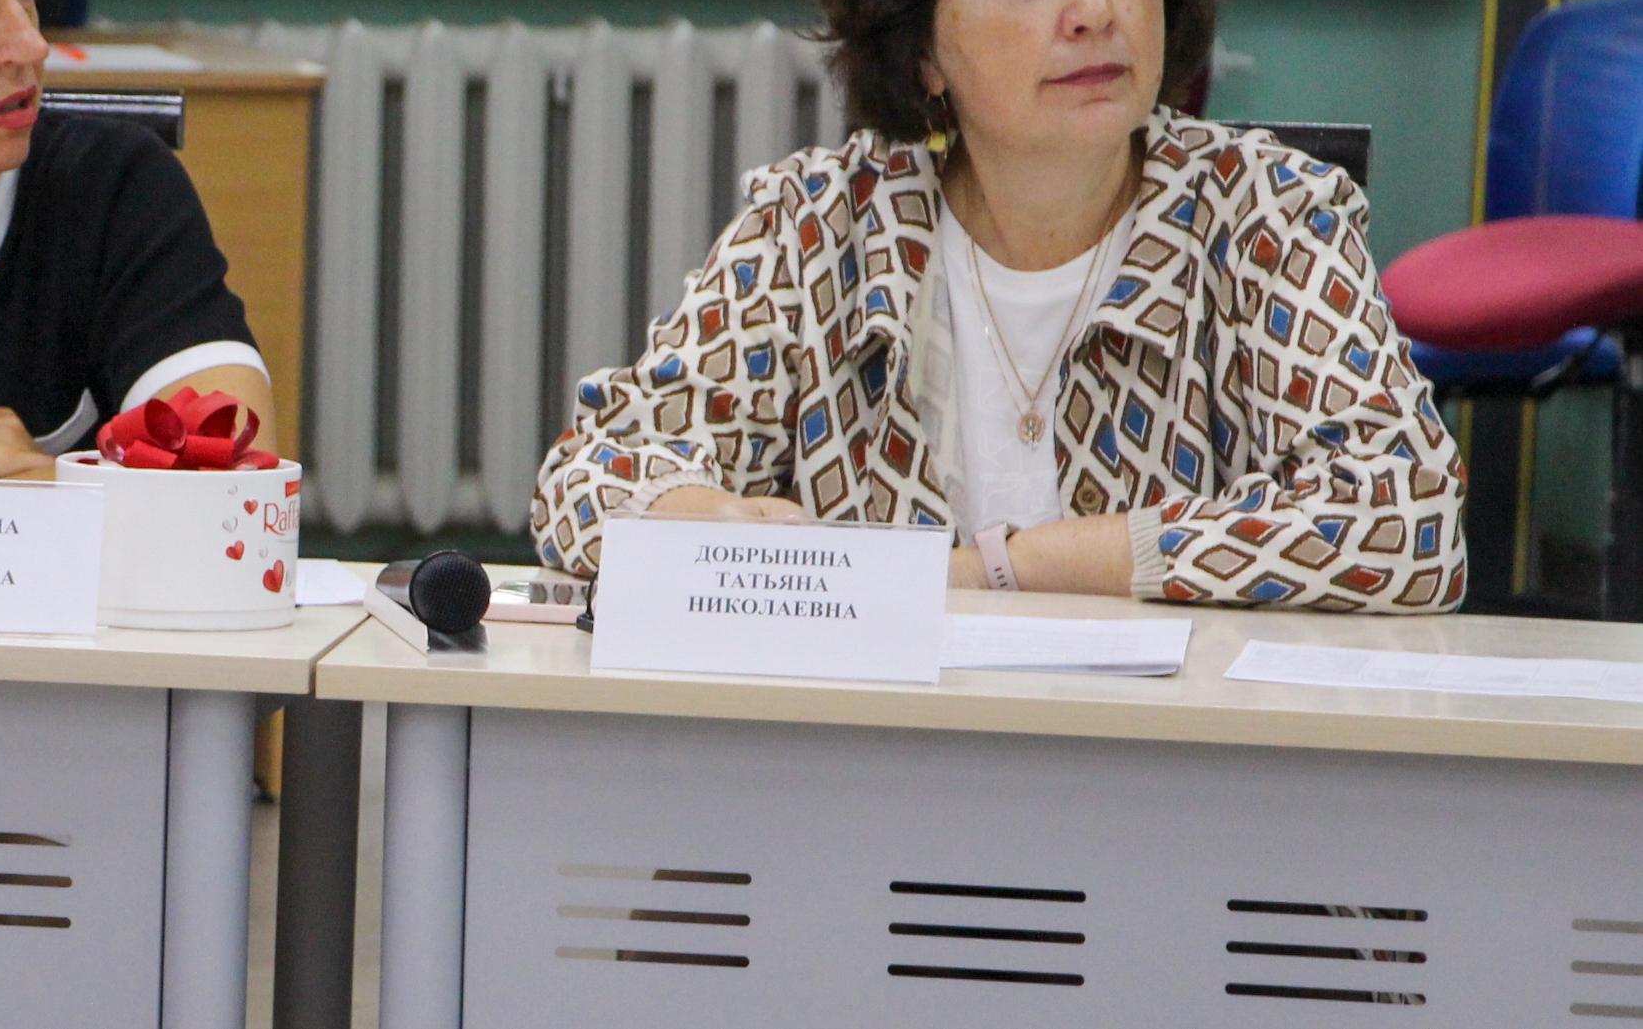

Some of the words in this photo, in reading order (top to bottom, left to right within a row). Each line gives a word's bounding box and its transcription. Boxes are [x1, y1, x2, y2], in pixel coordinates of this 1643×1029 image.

[694, 545, 852, 568] ДОБРЫНИНА
[715, 571, 828, 593] ТАТЬЯНА
[688, 595, 857, 620] НИКОЛАЕВНА
